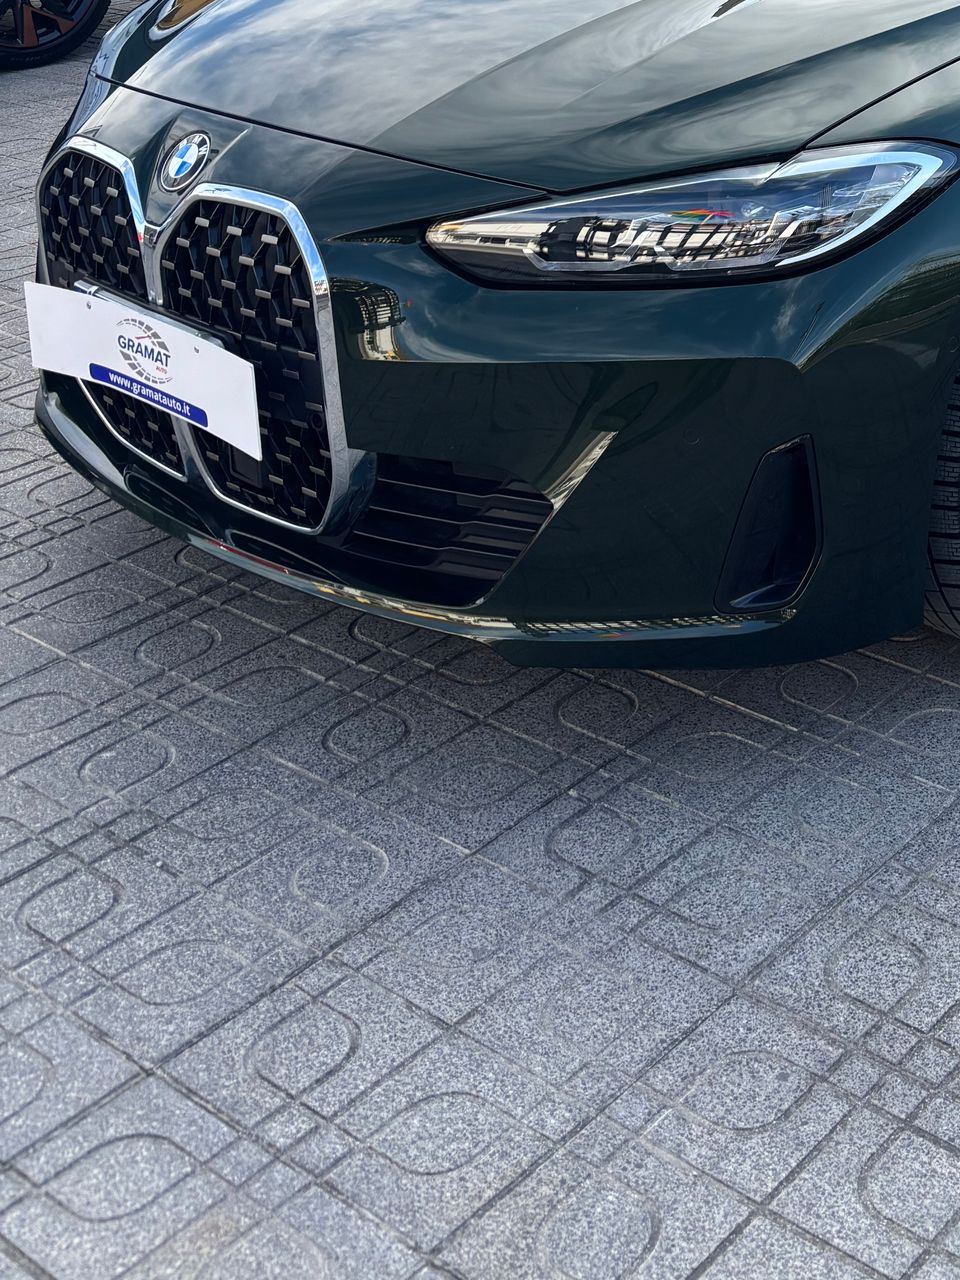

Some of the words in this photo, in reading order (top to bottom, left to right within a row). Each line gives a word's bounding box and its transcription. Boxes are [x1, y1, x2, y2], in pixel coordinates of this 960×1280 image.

[117, 334, 171, 368] GRAMAT
[155, 365, 168, 375] AUTO
[109, 371, 191, 417] www.gramatauto.it
